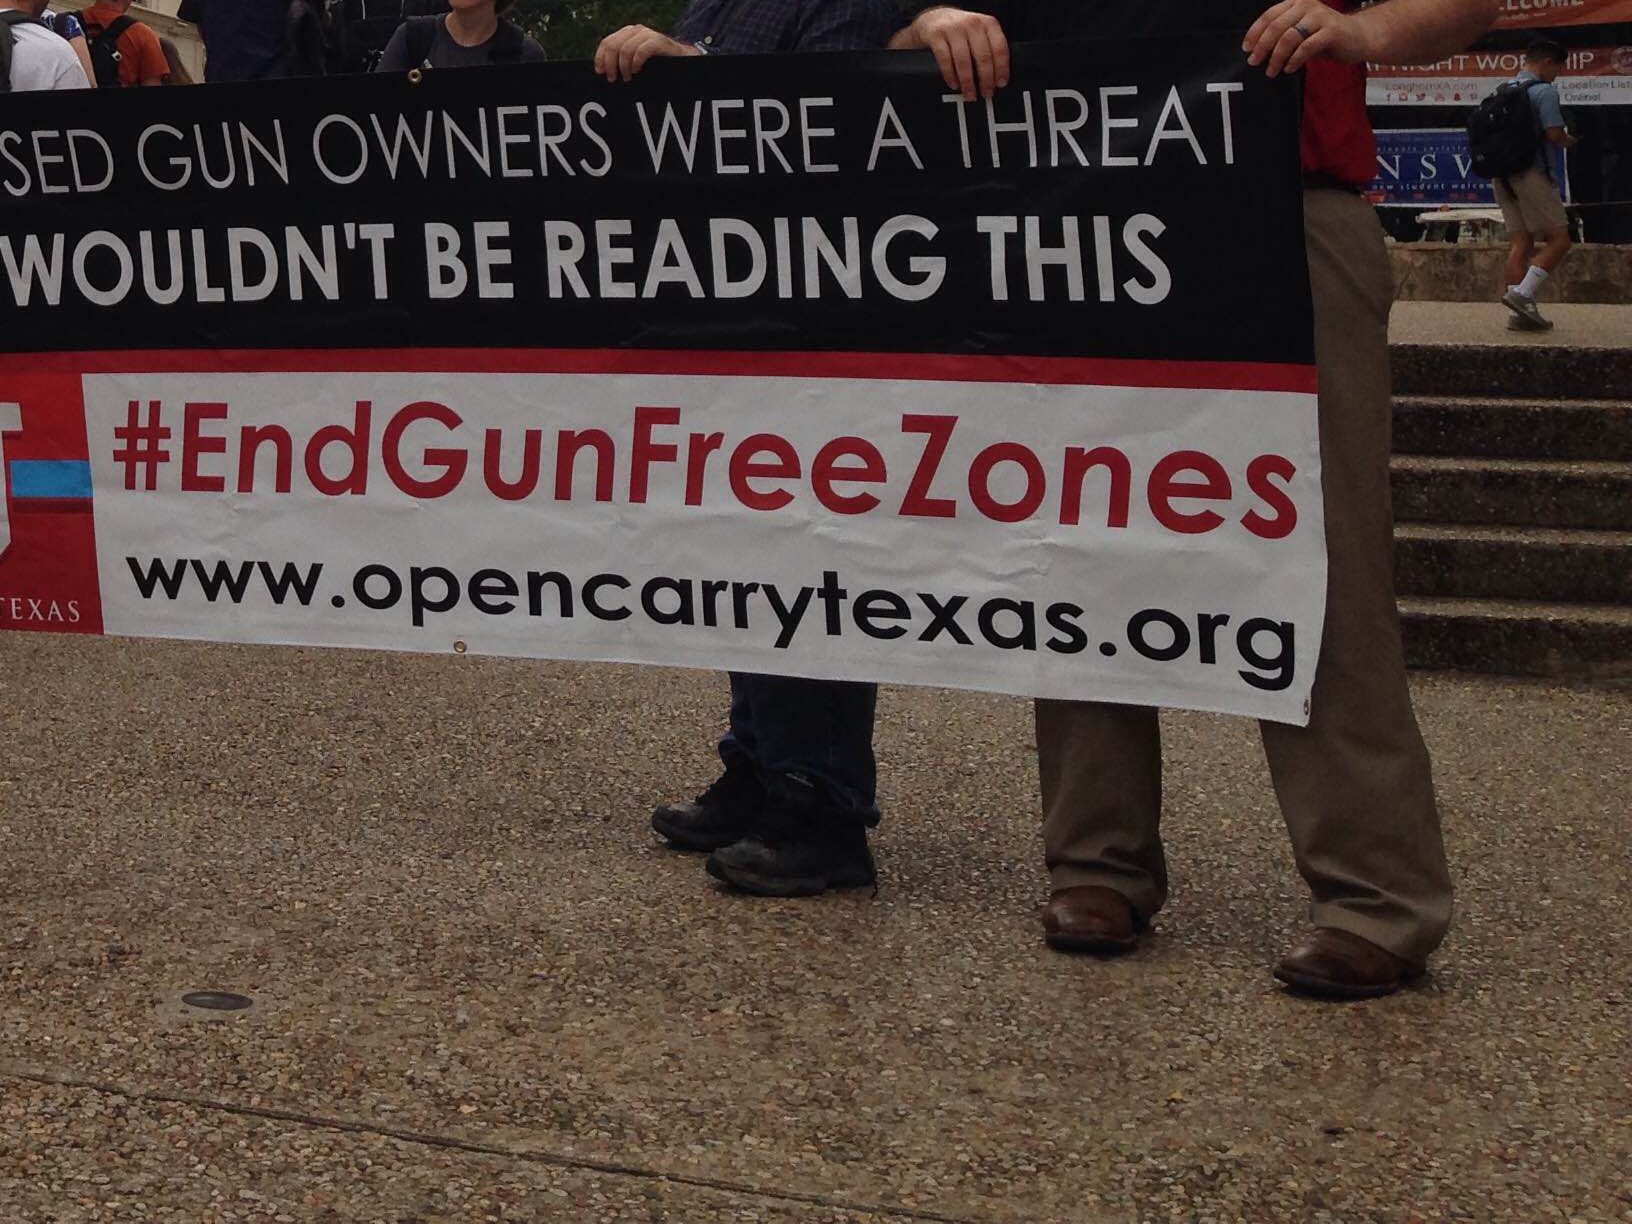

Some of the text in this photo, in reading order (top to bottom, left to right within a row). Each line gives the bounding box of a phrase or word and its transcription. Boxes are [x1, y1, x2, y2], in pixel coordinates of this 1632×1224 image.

[137, 119, 290, 191] GUN
[312, 101, 613, 185] OWNERS
[635, 97, 840, 175] WERE
[866, 97, 925, 172] A
[942, 82, 1244, 170] THREAT
[425, 221, 515, 300] BE
[544, 213, 947, 302] READING
[977, 212, 1172, 306] THIS
[112, 399, 1299, 542] #EndGunFreeZones
[125, 553, 1299, 692] www.opencarrytexas.org
